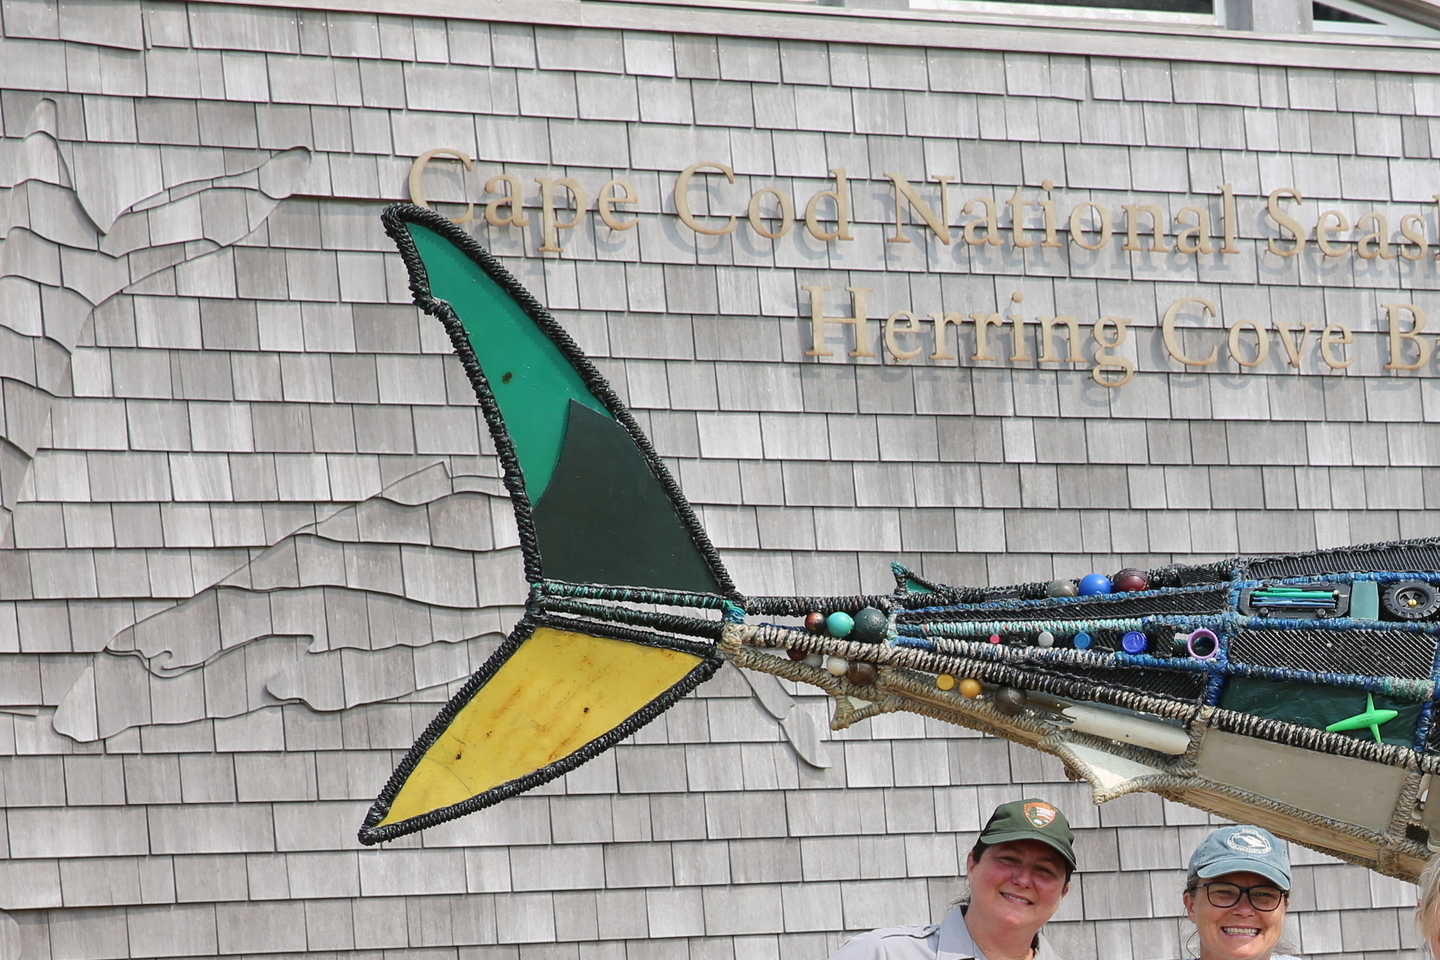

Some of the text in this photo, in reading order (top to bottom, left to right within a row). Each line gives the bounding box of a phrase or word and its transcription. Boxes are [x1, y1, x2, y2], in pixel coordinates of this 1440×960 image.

[408, 147, 639, 253] Cape
[674, 160, 854, 239] Cod
[883, 172, 1240, 256] National
[800, 285, 1134, 388] Herring
[1161, 296, 1355, 371] Cove
